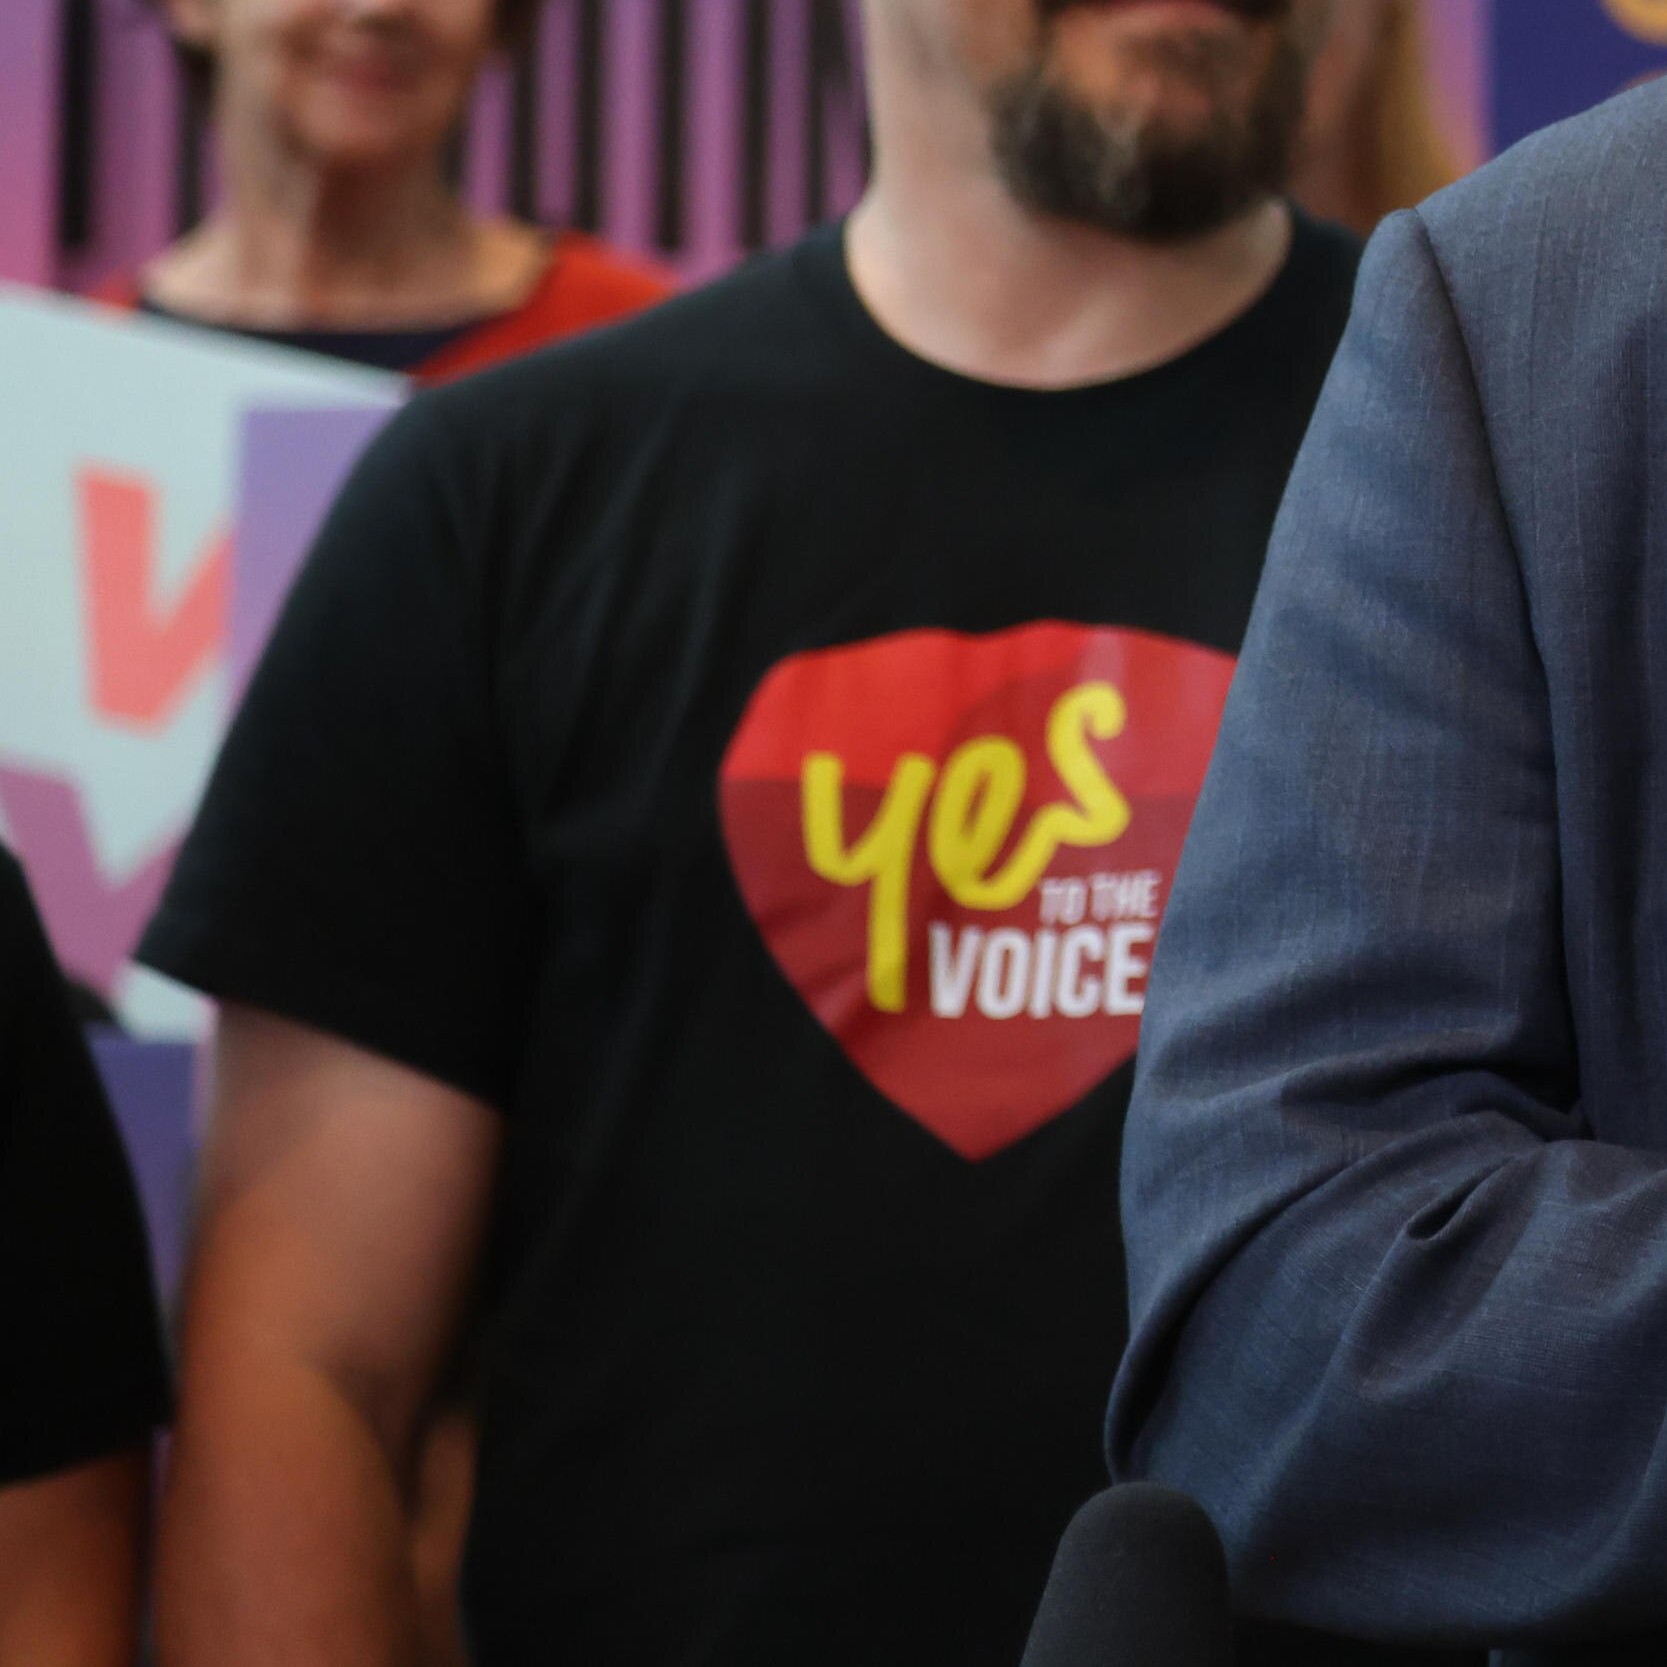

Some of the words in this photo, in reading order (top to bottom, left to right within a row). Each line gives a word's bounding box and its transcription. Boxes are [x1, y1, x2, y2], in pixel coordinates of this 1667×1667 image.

[801, 678, 1132, 1014] yes
[1038, 877, 1090, 925] TO
[1092, 871, 1162, 921] THE
[927, 920, 1158, 1020] VOICE
